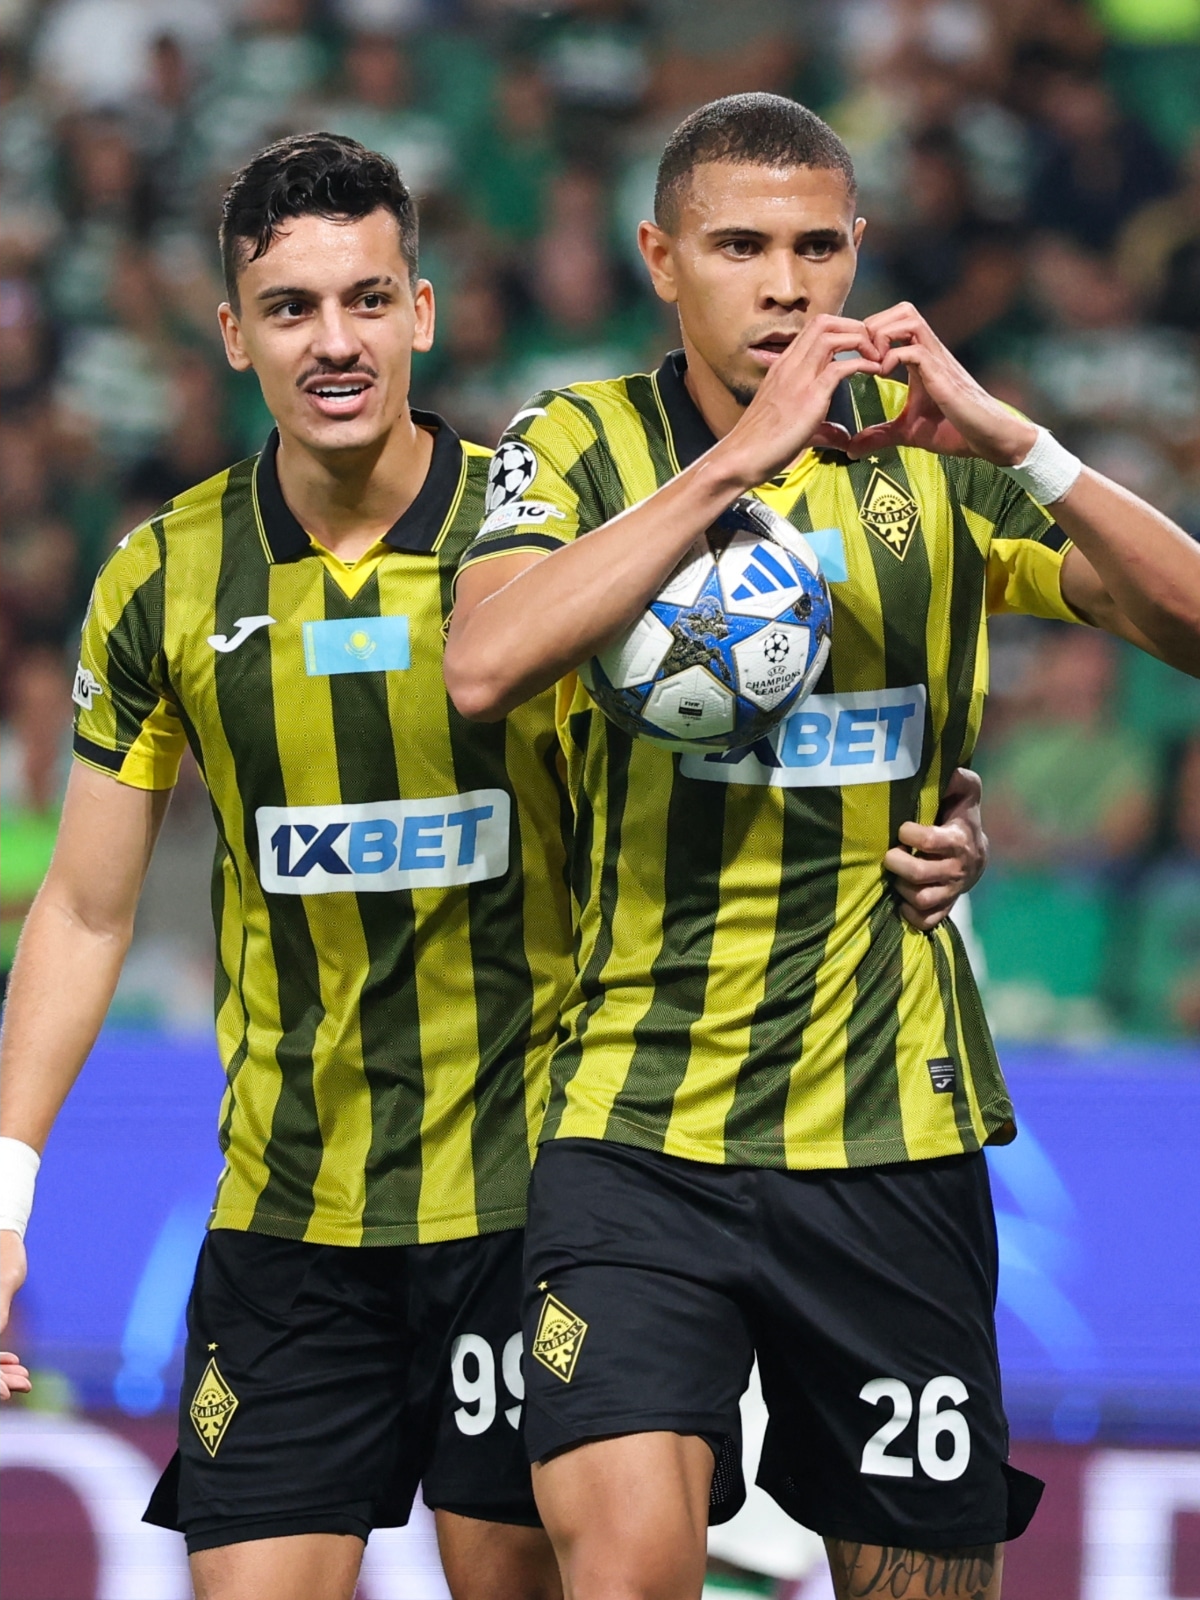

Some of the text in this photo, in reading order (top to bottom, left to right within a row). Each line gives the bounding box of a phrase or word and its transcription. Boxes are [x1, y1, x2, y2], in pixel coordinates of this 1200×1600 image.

[745, 669, 801, 690] CHAMPIONS
[755, 680, 792, 696] LEAGUE
[767, 665, 787, 677] UEFA
[704, 703, 916, 769] BET
[271, 805, 494, 878] 1XBET
[858, 1375, 971, 1481] 26
